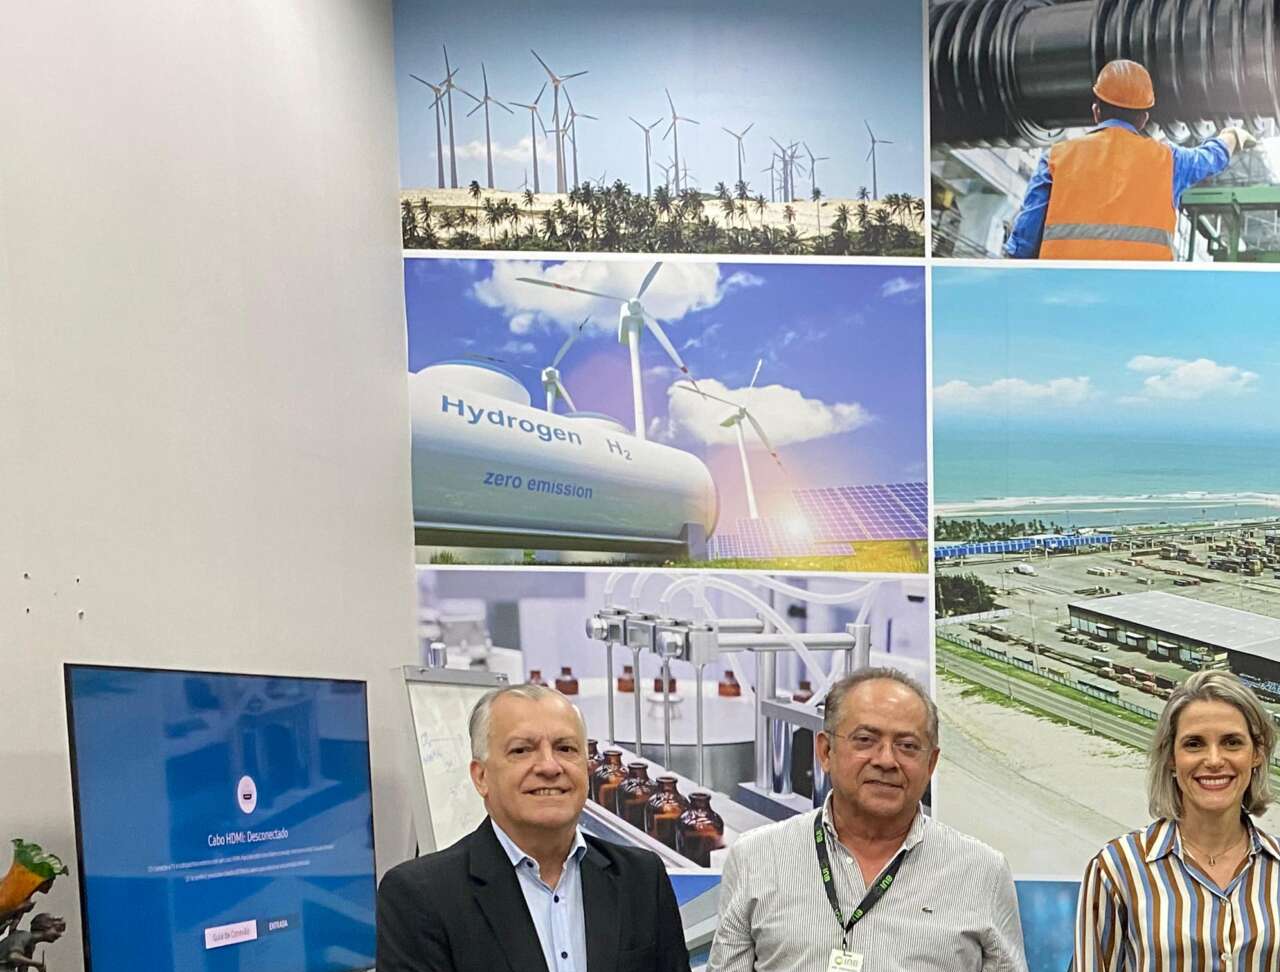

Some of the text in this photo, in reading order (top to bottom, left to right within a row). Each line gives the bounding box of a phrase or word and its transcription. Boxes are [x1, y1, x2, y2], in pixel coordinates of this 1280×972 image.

[441, 395, 582, 445] Hydrogen
[483, 471, 593, 499] zero emission
[207, 833, 225, 847] Cabo
[247, 827, 289, 842] Desconectado
